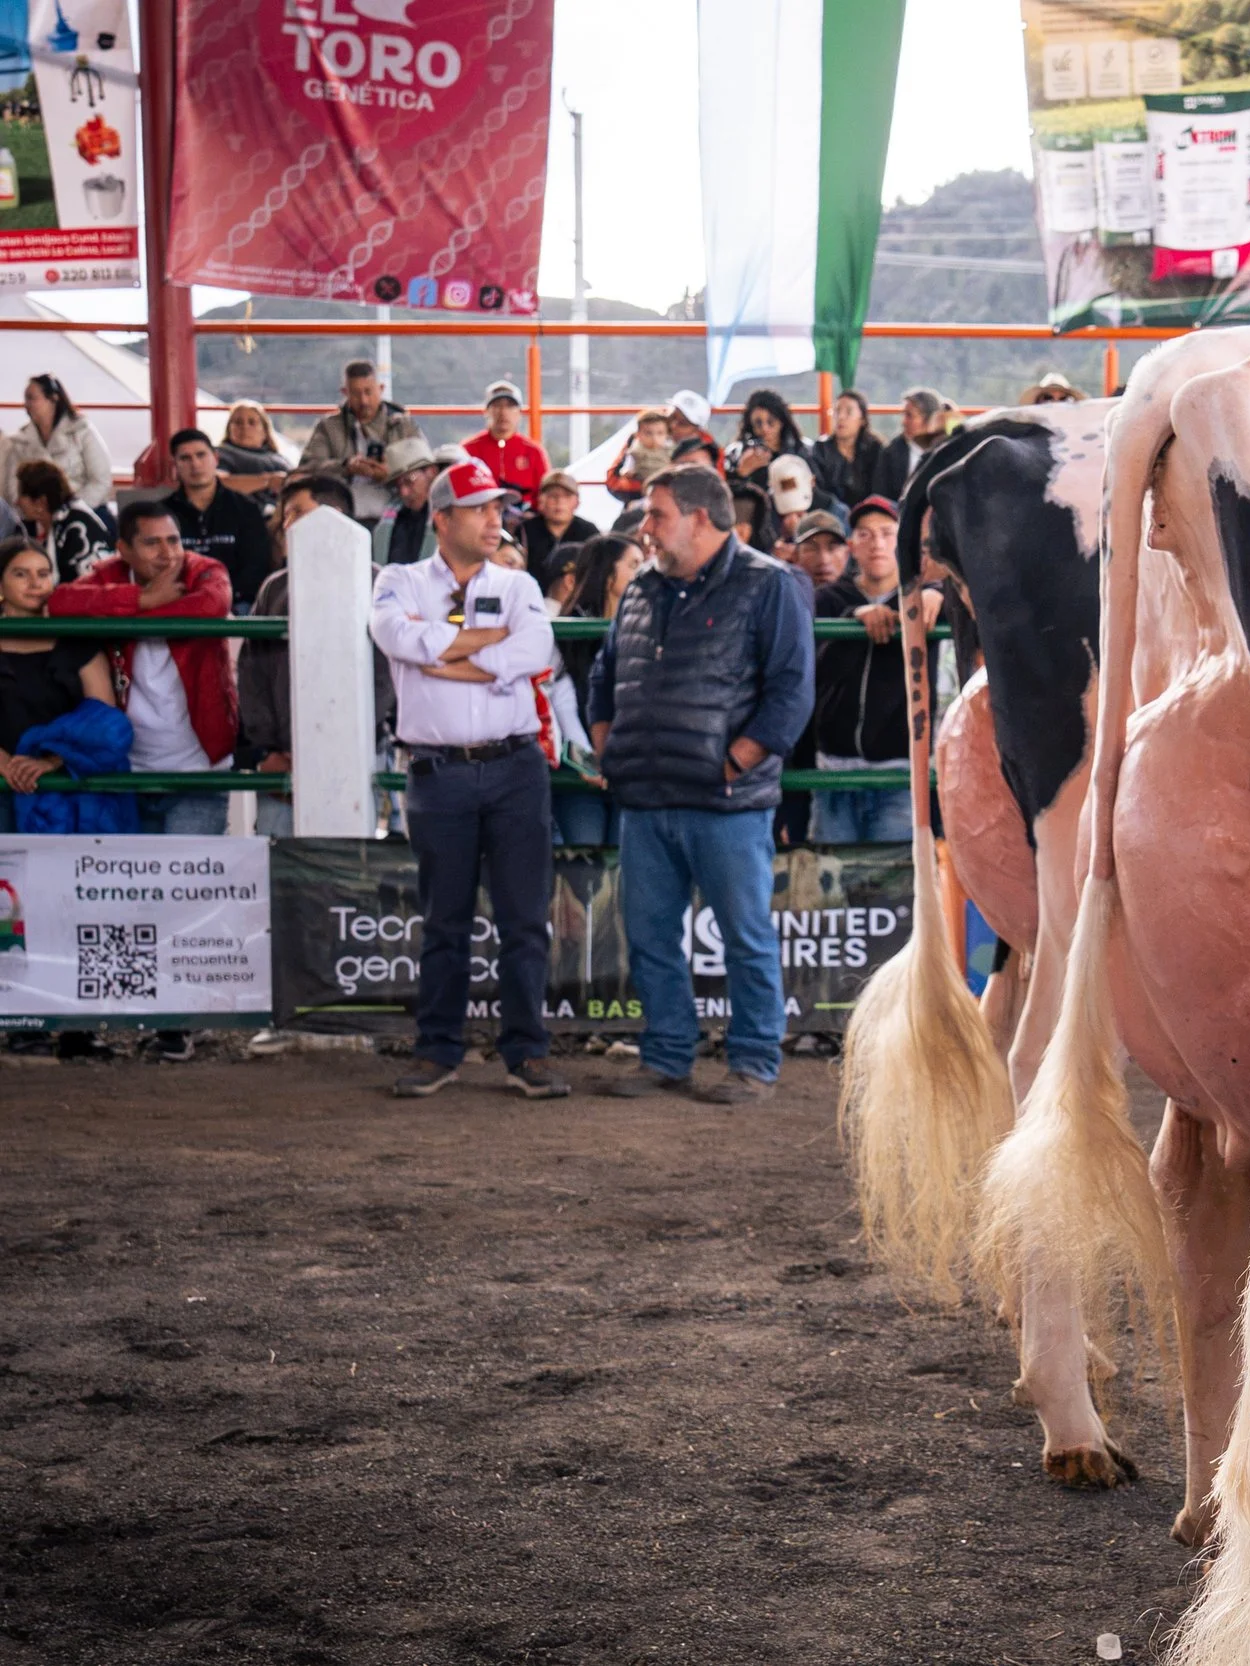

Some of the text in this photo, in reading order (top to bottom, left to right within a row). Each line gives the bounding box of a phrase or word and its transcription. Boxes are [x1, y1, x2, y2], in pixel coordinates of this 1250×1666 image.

[281, 22, 462, 89] TORO
[303, 77, 435, 112] GENÉTICA
[75, 855, 225, 878] ¡Porque cada
[75, 882, 257, 901] ternera cuenta!
[172, 954, 248, 966] encuentra
[173, 971, 255, 983] a tu asesor
[541, 999, 643, 1019] LA BAS
